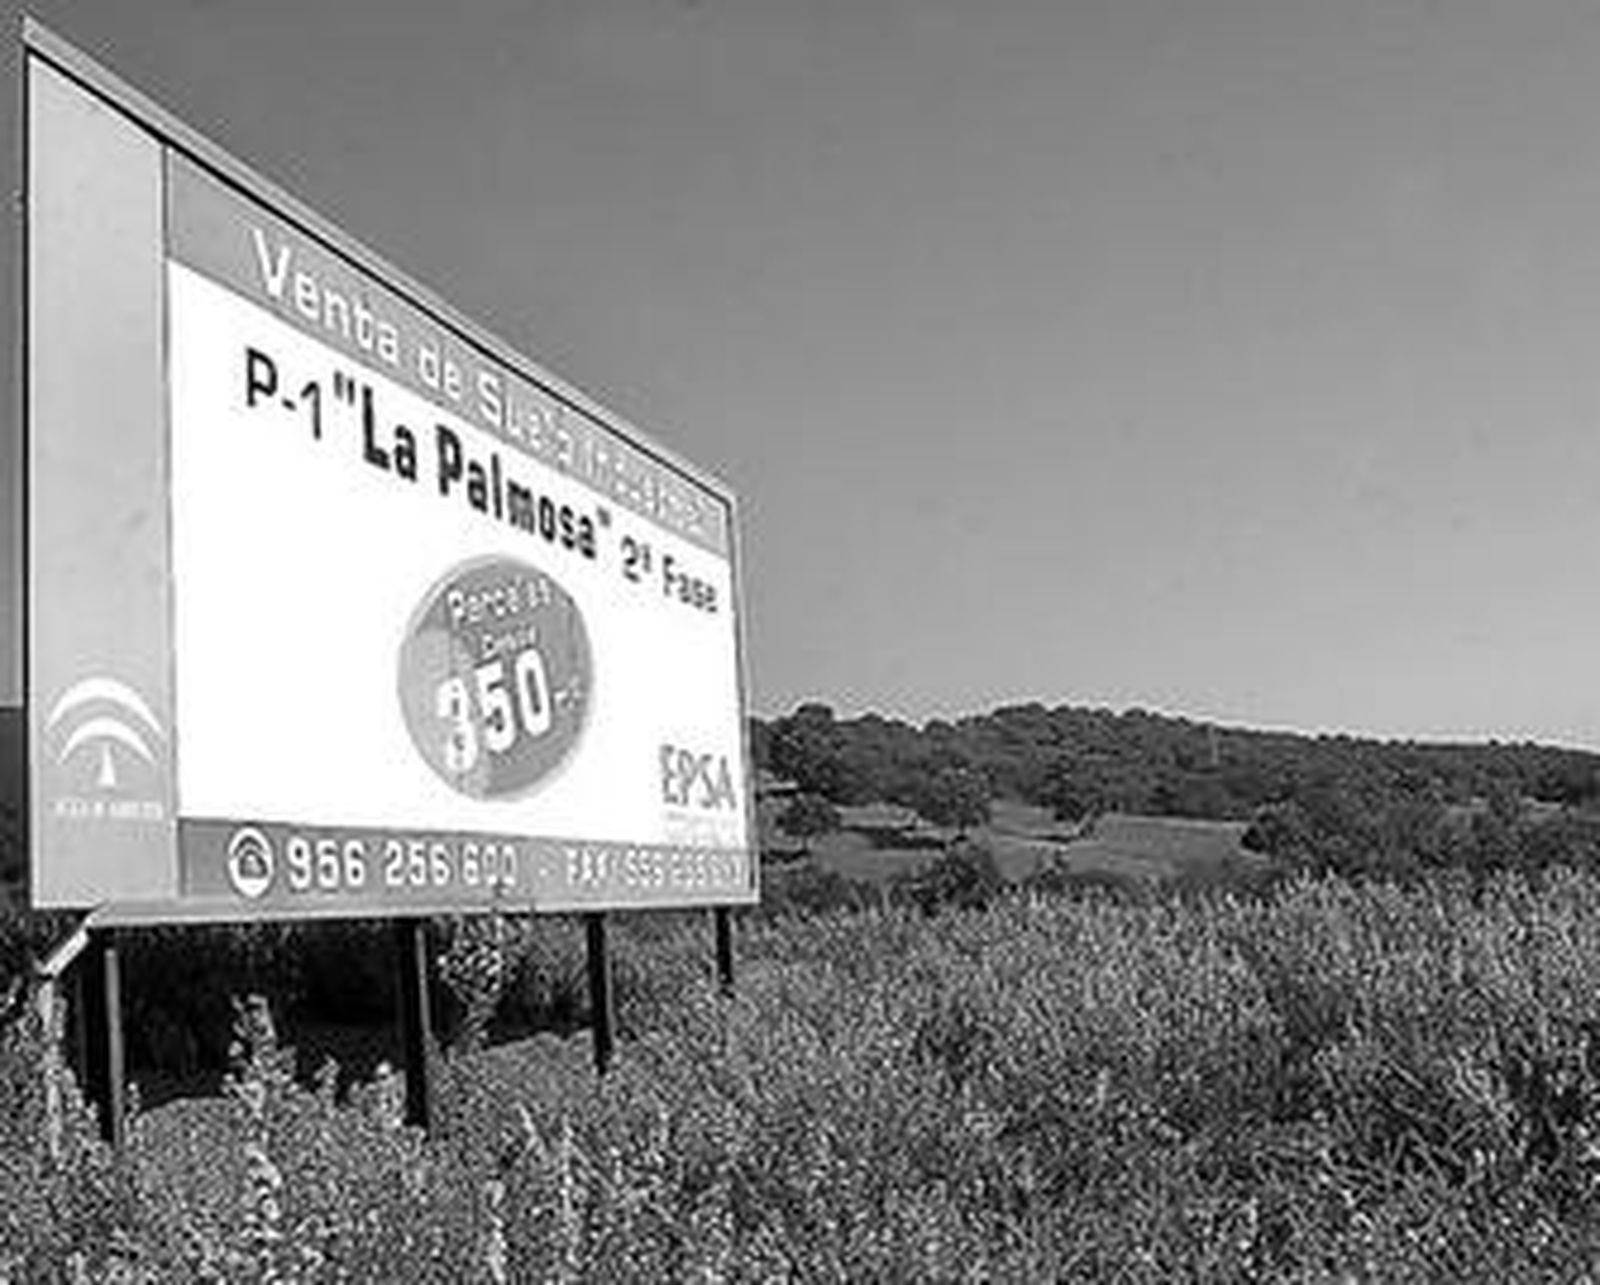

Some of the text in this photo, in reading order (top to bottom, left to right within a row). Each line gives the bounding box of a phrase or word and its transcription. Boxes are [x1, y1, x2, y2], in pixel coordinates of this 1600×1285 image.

[253, 228, 399, 364] Venta
[419, 340, 462, 400] de
[434, 646, 553, 774] 350
[658, 743, 737, 811] EPSA
[287, 836, 364, 889] 956
[384, 839, 450, 887] 256
